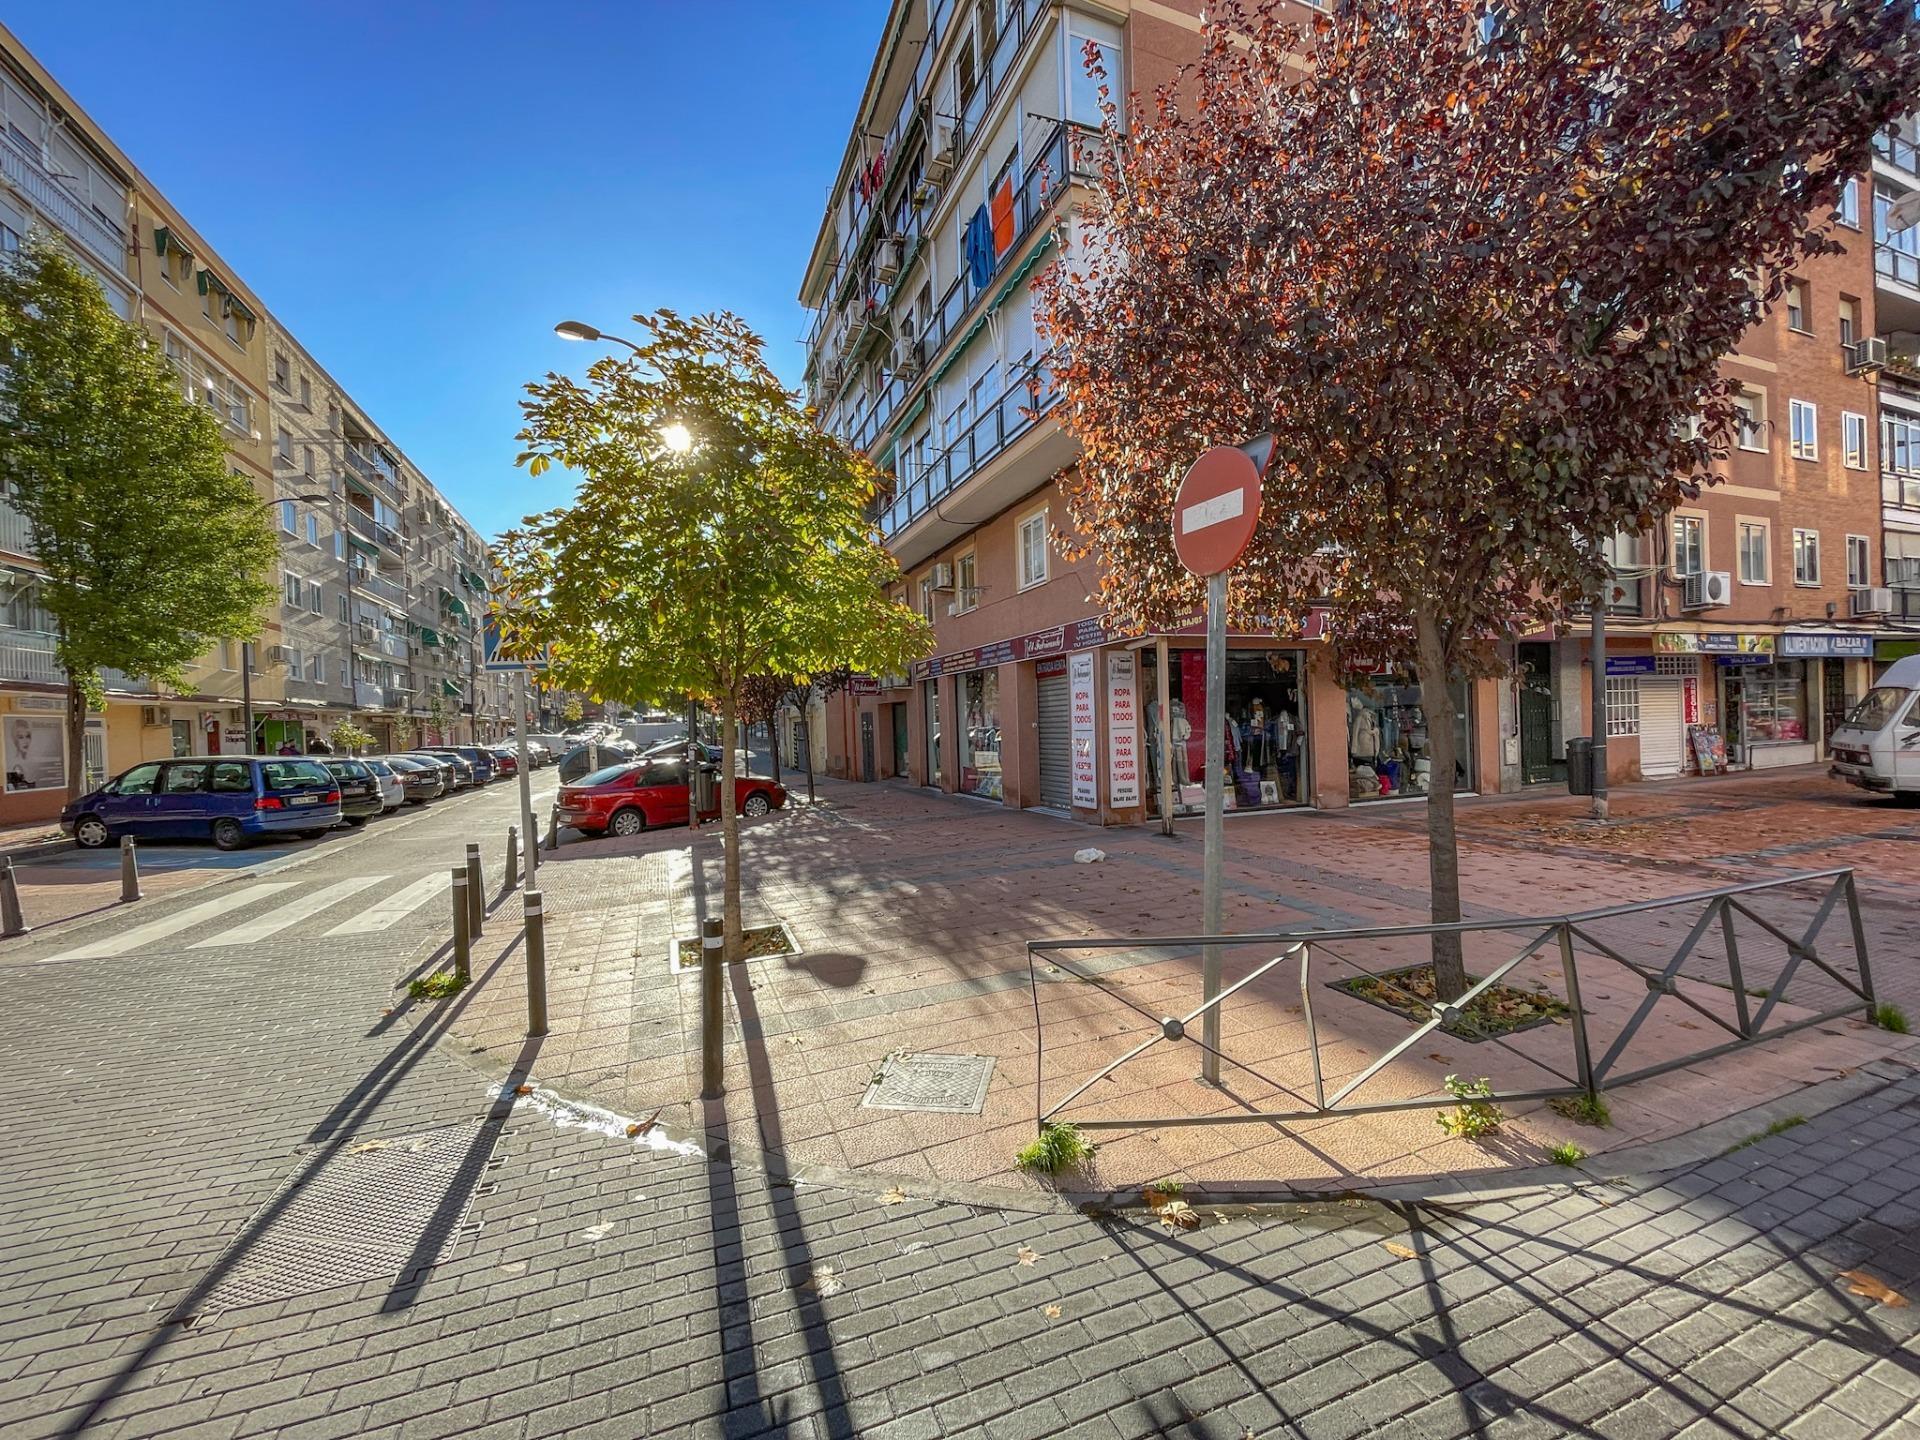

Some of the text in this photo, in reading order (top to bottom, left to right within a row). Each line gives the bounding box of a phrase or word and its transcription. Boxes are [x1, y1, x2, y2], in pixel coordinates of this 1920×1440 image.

[1836, 637, 1861, 649] BAZAR
[1075, 692, 1089, 700] ROPA
[1114, 688, 1130, 697] ROPA
[1076, 704, 1089, 712] PARA
[1115, 700, 1130, 709] PARA
[1074, 715, 1091, 724] TODOS
[1112, 713, 1133, 721] TODOS
[1115, 736, 1132, 745] TODO
[1116, 748, 1131, 757] PARA
[1075, 761, 1091, 770] VESTIR
[1114, 760, 1134, 769] VESTIR
[1074, 773, 1093, 783] TU HOGAR
[1113, 773, 1136, 781] TU HOGAR
